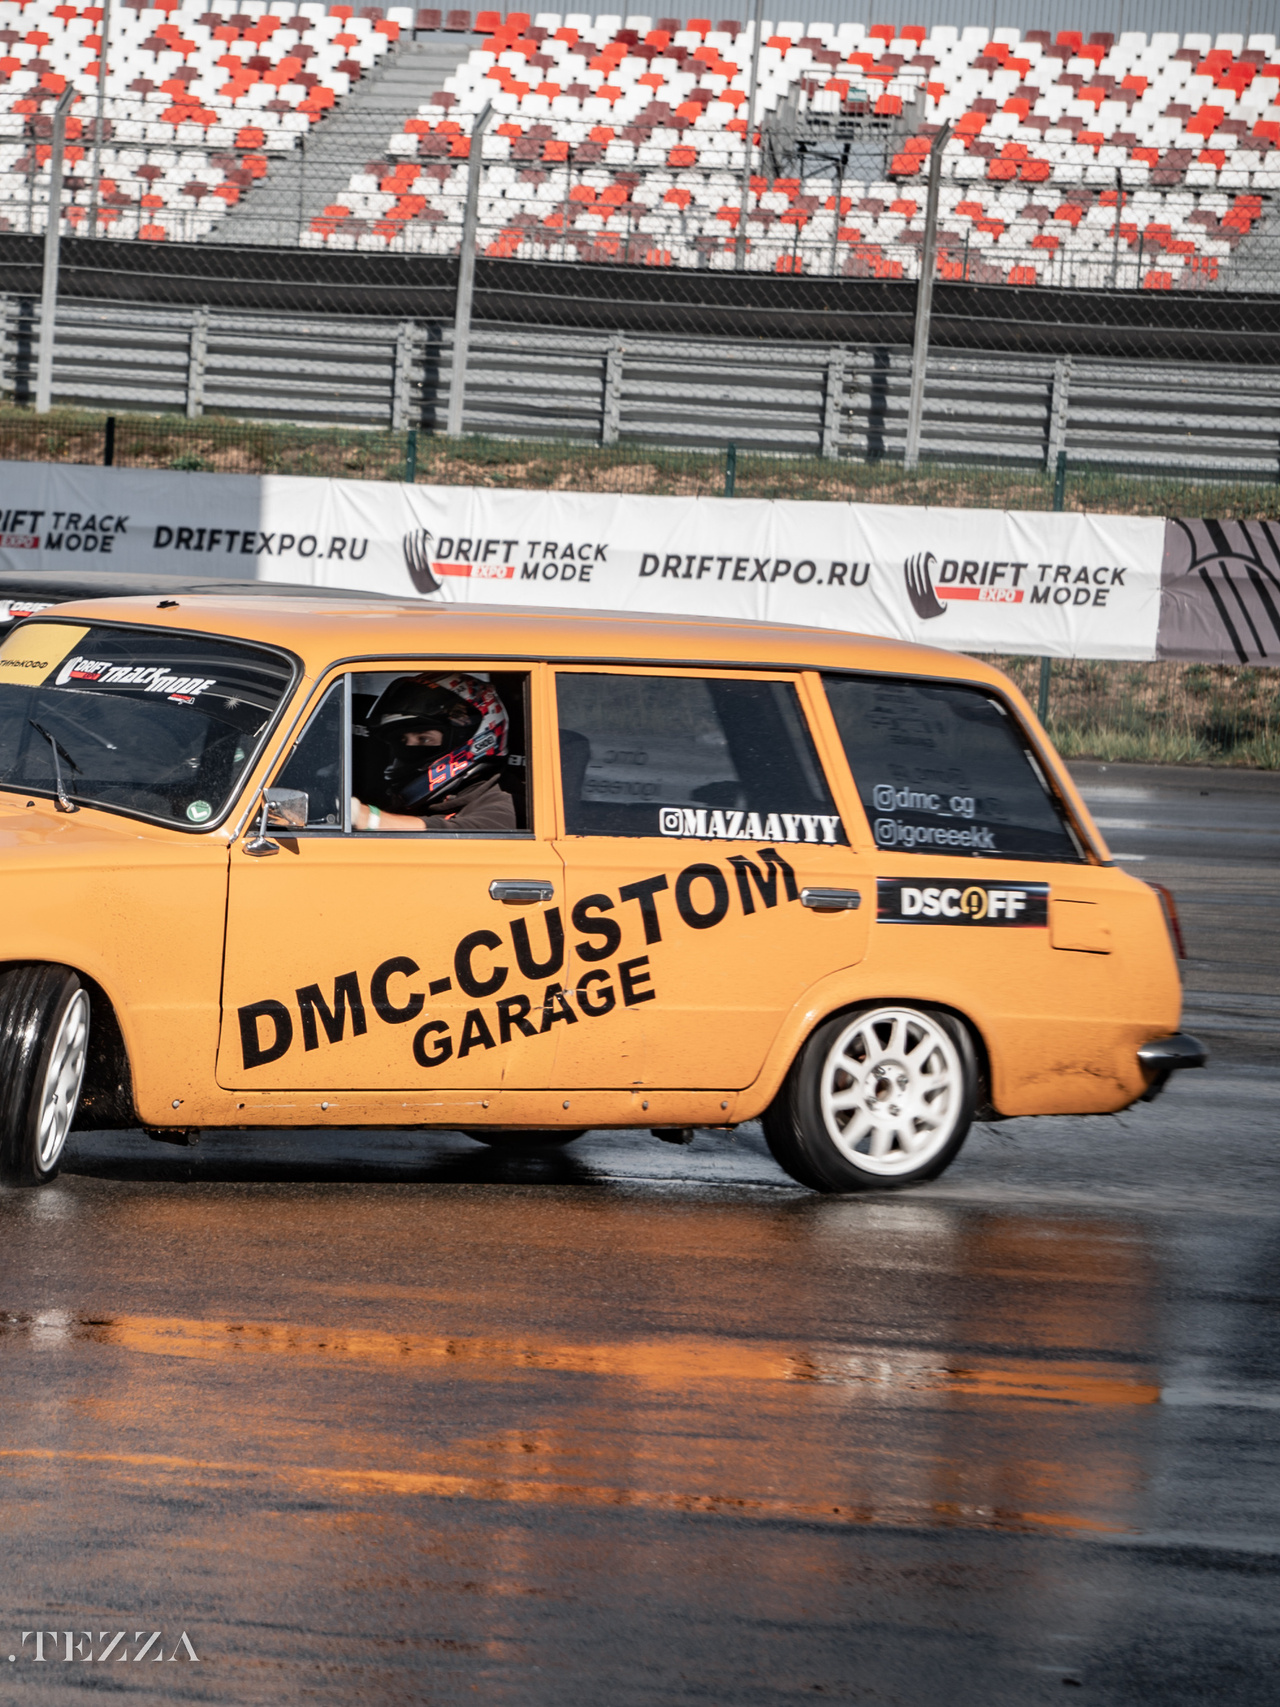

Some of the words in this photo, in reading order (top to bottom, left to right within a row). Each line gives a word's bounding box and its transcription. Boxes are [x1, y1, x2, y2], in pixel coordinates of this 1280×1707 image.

[52, 512, 129, 534] TRACK
[1, 535, 35, 549] EXPO
[44, 534, 116, 553] MODE
[153, 525, 369, 560] DRIFTEXPO.RU
[435, 537, 519, 564] DRIFT
[527, 541, 610, 562] TRACK
[470, 566, 508, 579] EXPO
[520, 562, 593, 583] MODE
[639, 553, 871, 587] DRIFTEXPO.RU
[938, 560, 1029, 586] DRIFT
[1036, 564, 1128, 586] TRACK
[978, 588, 1016, 602] EXPO
[1029, 586, 1111, 608] MODE
[75, 659, 113, 674] DRIFT
[894, 785, 976, 818] dmc_cg
[237, 847, 800, 1070] DMC-CUSTOM
[412, 955, 657, 1068] GARAGE
